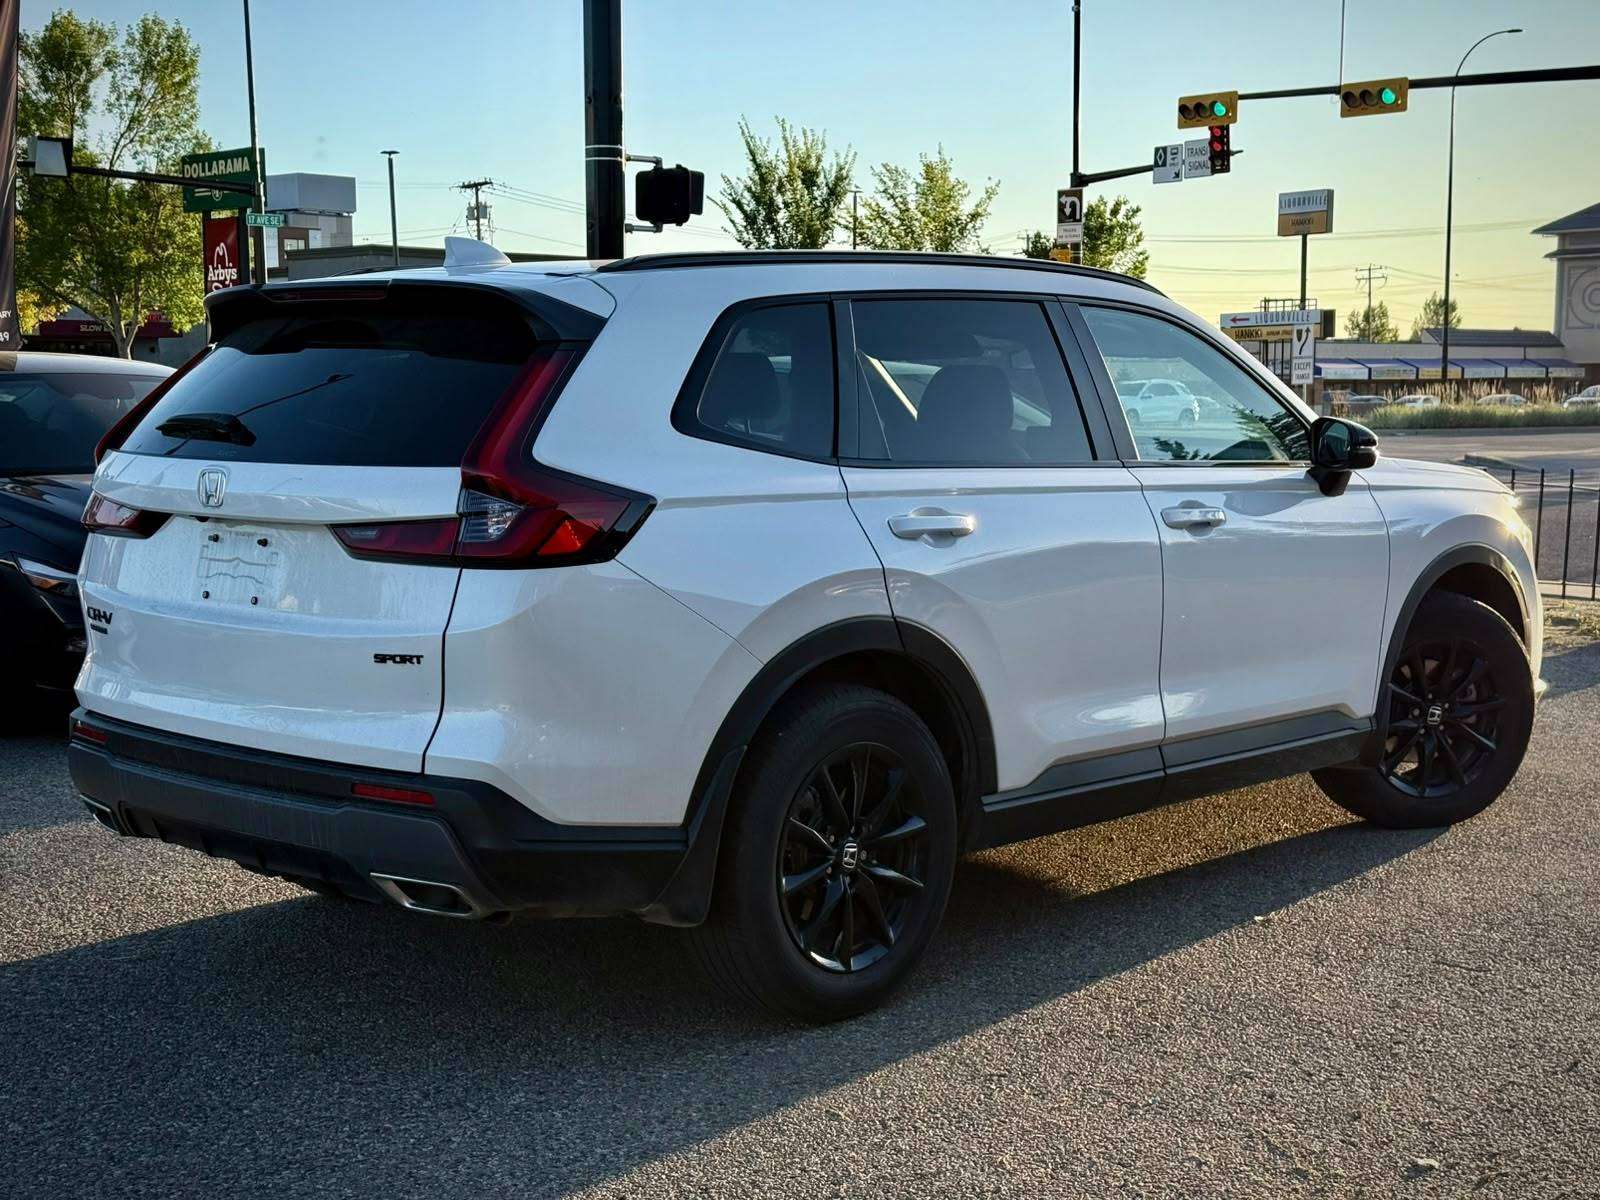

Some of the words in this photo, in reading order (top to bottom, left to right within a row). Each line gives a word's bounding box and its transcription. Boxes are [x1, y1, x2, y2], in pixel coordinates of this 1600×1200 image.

[184, 156, 251, 178] DOLLARAMA
[1188, 160, 1210, 171] SIGNAL
[248, 215, 255, 224] 17
[256, 215, 269, 224] AVE
[270, 216, 280, 225] SE
[208, 263, 238, 284] Arby's
[1255, 311, 1311, 325] LIQUORVILLE
[1234, 328, 1264, 341] HANKKI
[1294, 361, 1312, 371] EXCEPT
[87, 606, 113, 625] CR-V
[374, 653, 424, 665] SPORT
